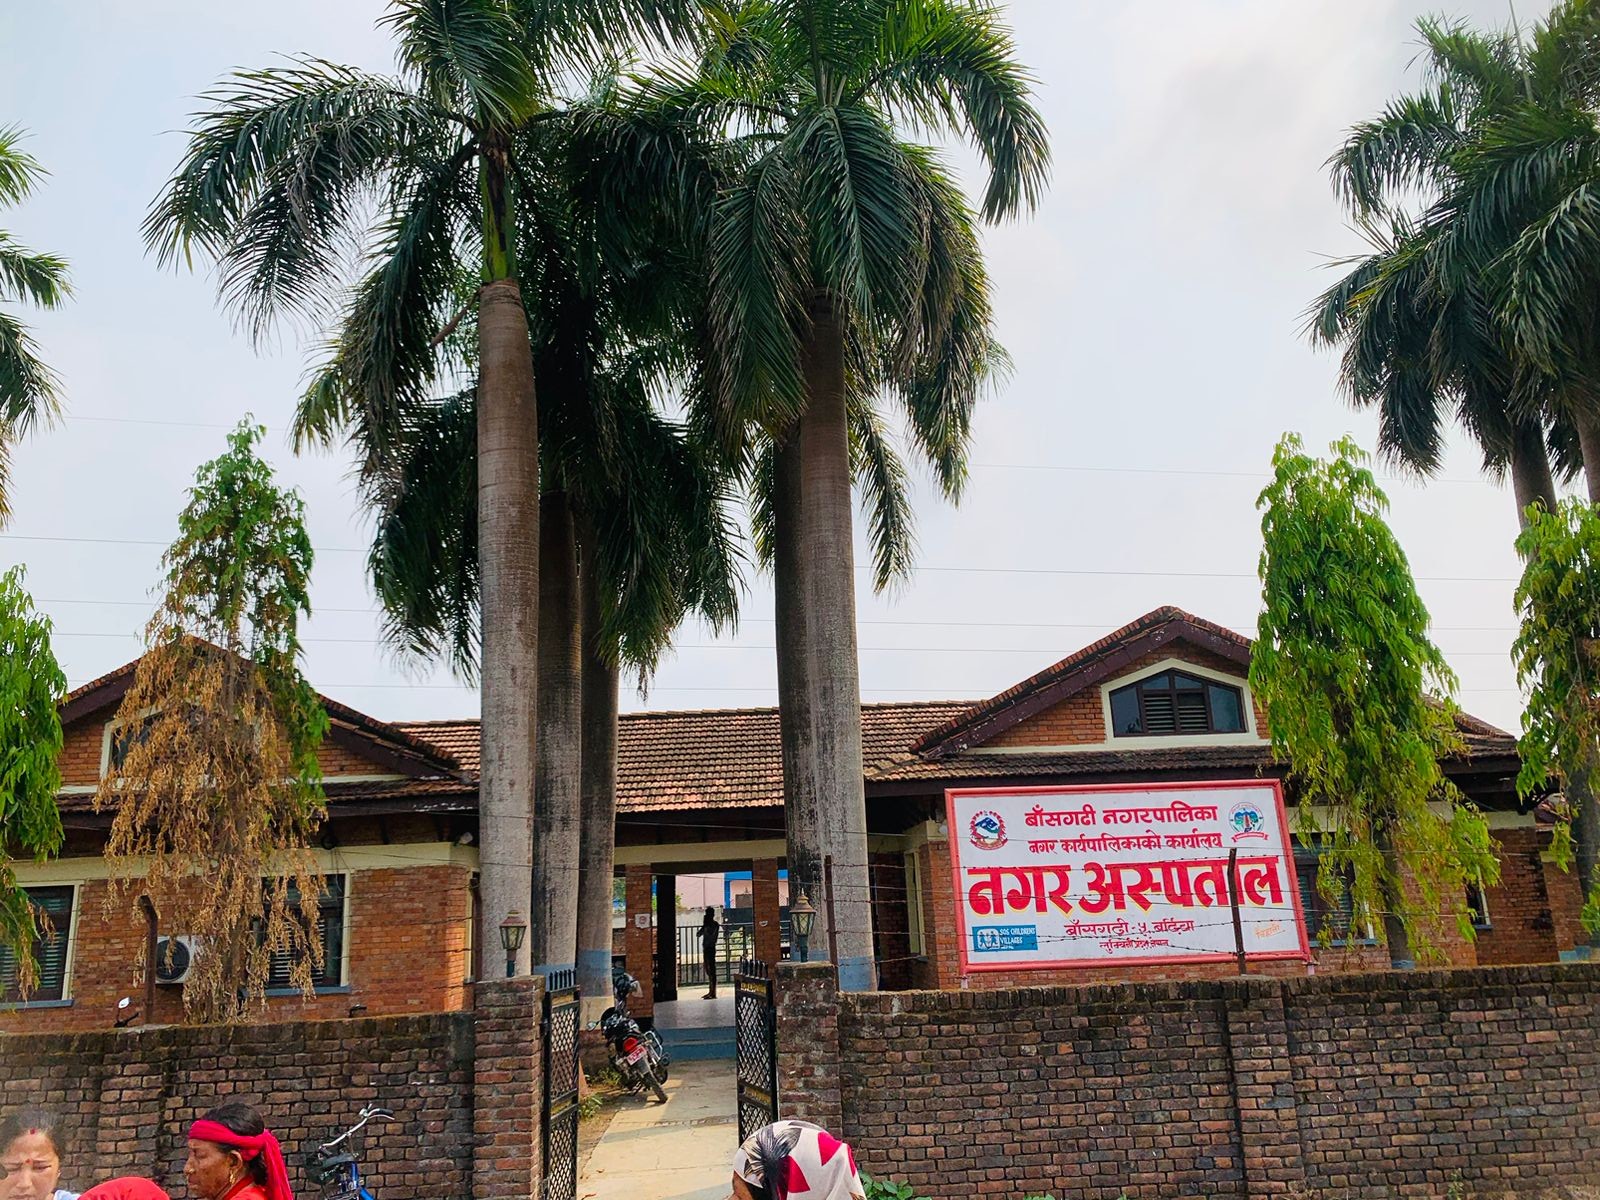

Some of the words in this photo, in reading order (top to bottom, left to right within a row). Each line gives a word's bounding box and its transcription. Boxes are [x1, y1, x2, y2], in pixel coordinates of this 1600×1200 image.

[1103, 800, 1218, 824] नगरपालिका
[1028, 839, 1058, 854] नगर
[1060, 829, 1161, 852] कार्यपालिकाको
[1164, 828, 1223, 850] कार्यालय
[967, 864, 1074, 917] नगर
[1078, 855, 1285, 912] अस्पताल
